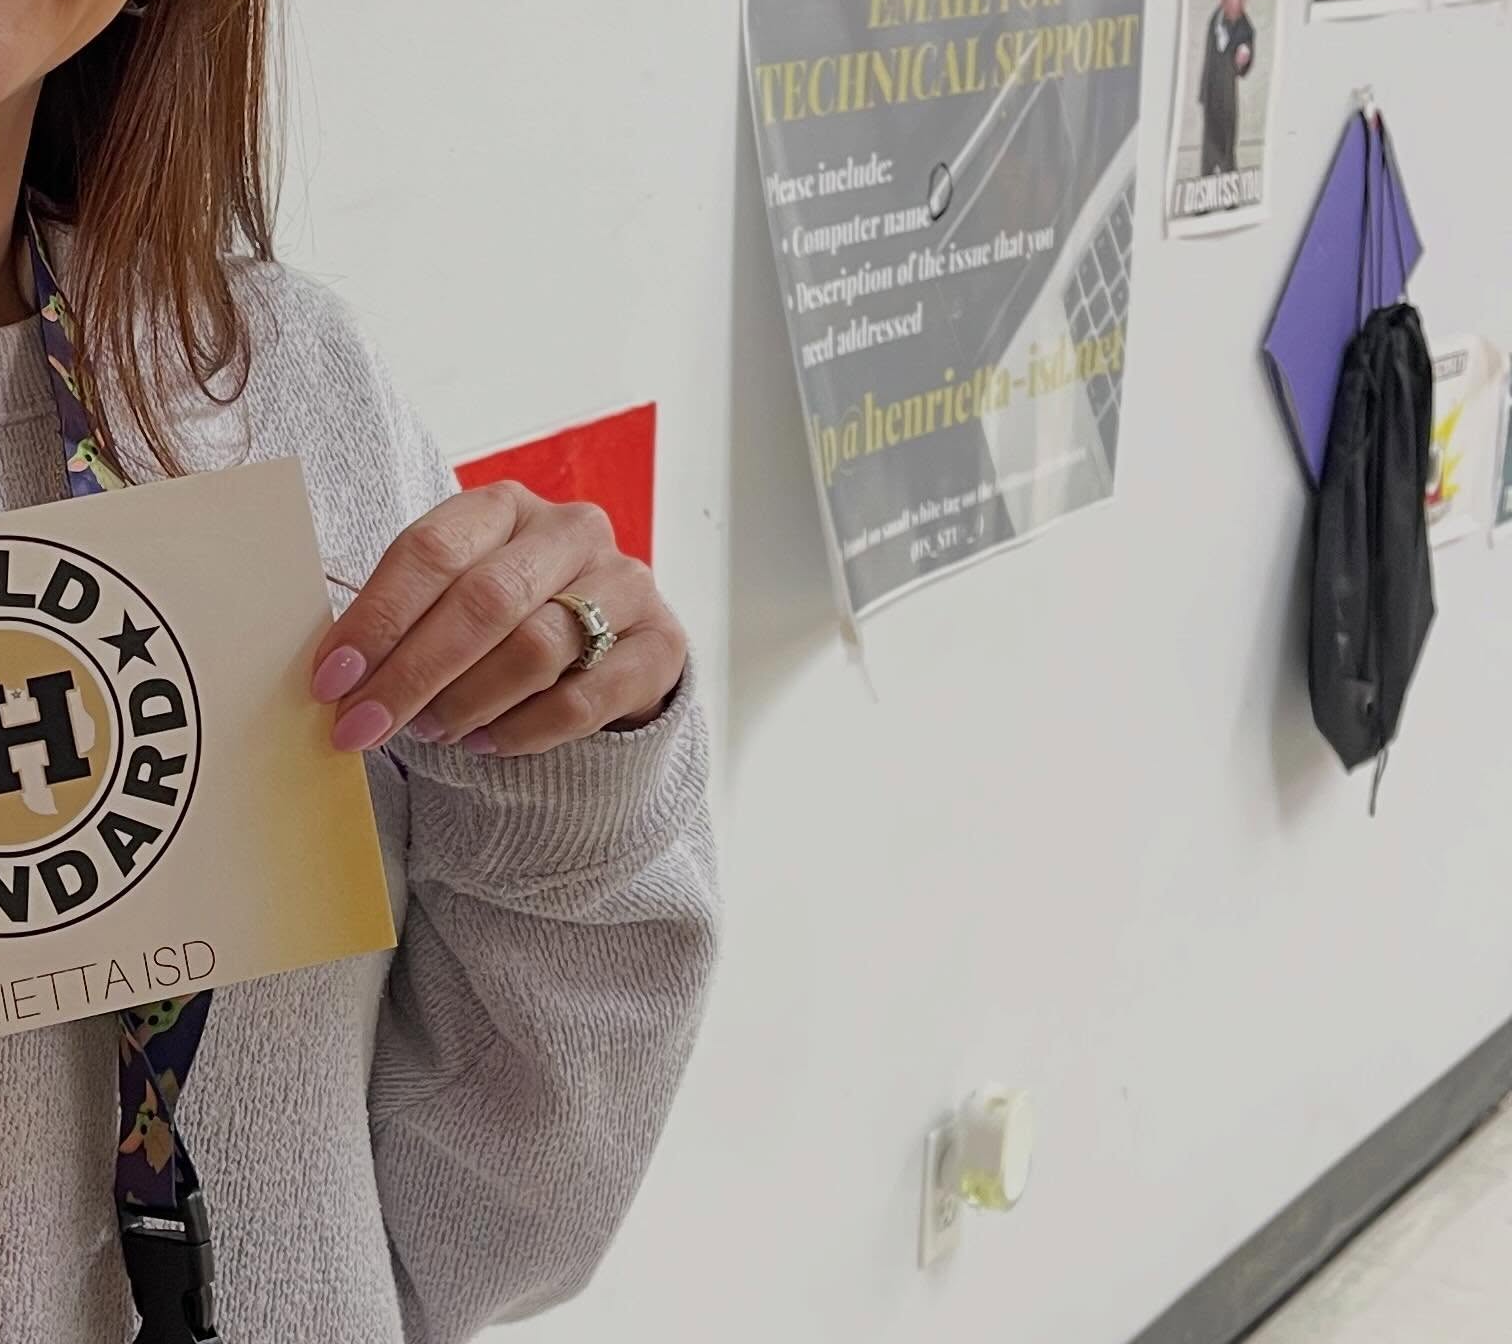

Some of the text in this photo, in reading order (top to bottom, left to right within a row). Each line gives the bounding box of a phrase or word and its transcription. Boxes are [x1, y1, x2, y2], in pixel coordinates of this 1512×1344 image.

[754, 14, 1140, 127] TECHNICAL SUPPORT
[765, 152, 894, 209] Please include:
[792, 204, 931, 258] Computer name
[796, 260, 895, 314] Description
[896, 249, 918, 287] of
[917, 246, 946, 282] the
[993, 229, 1024, 263] that
[1022, 226, 1055, 261] you
[801, 301, 924, 370] need addressed
[144, 938, 218, 991] ISD
